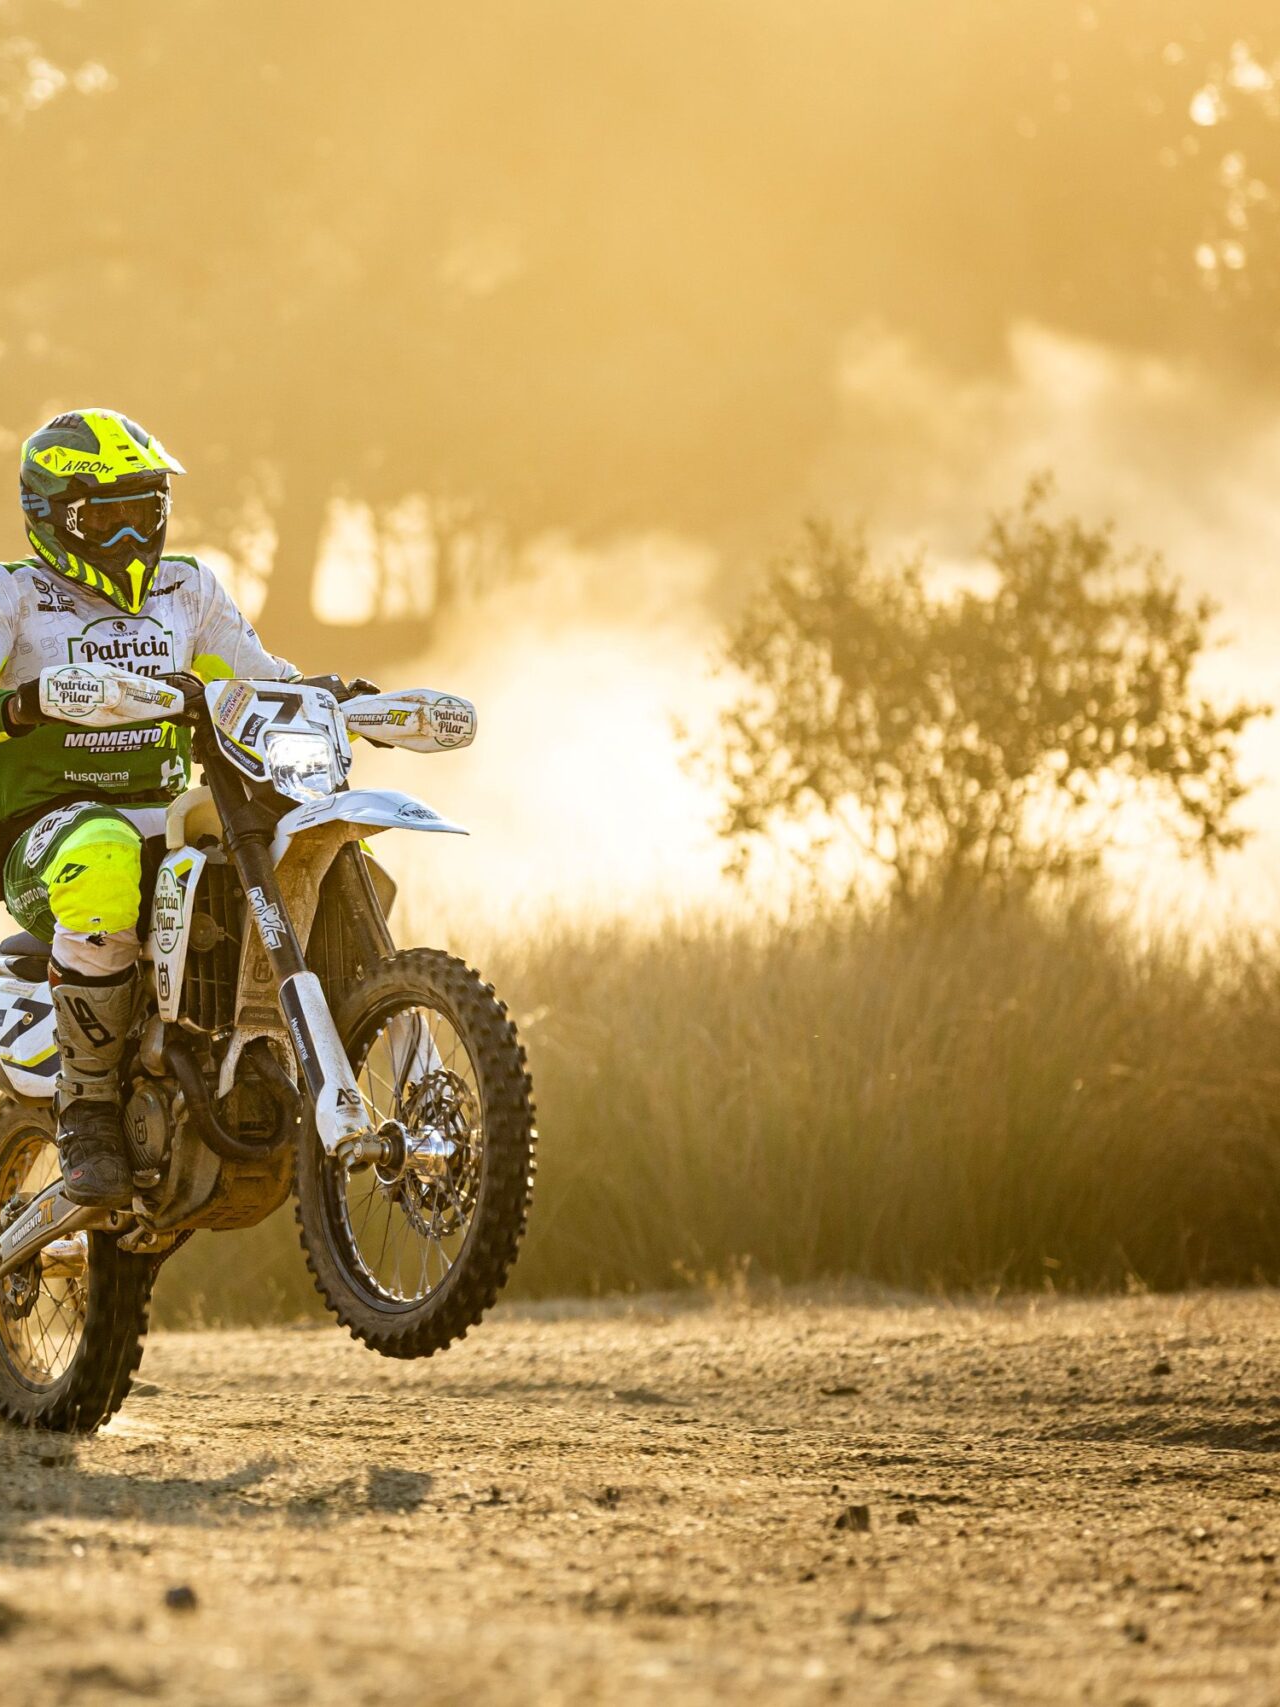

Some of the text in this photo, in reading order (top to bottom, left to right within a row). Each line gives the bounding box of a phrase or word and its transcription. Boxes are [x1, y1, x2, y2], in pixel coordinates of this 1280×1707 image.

[59, 690, 93, 703] Pilar
[256, 691, 304, 725] 7
[349, 713, 393, 722] MOMENTO
[438, 721, 463, 734] Pilar
[63, 727, 162, 748] MOMENTO
[89, 744, 143, 754] MOTOS
[229, 744, 260, 770] Husqvarna
[63, 770, 130, 783] Husqvarna
[290, 1017, 310, 1061] Husqvarna
[11, 1209, 42, 1248] MOMENTO
